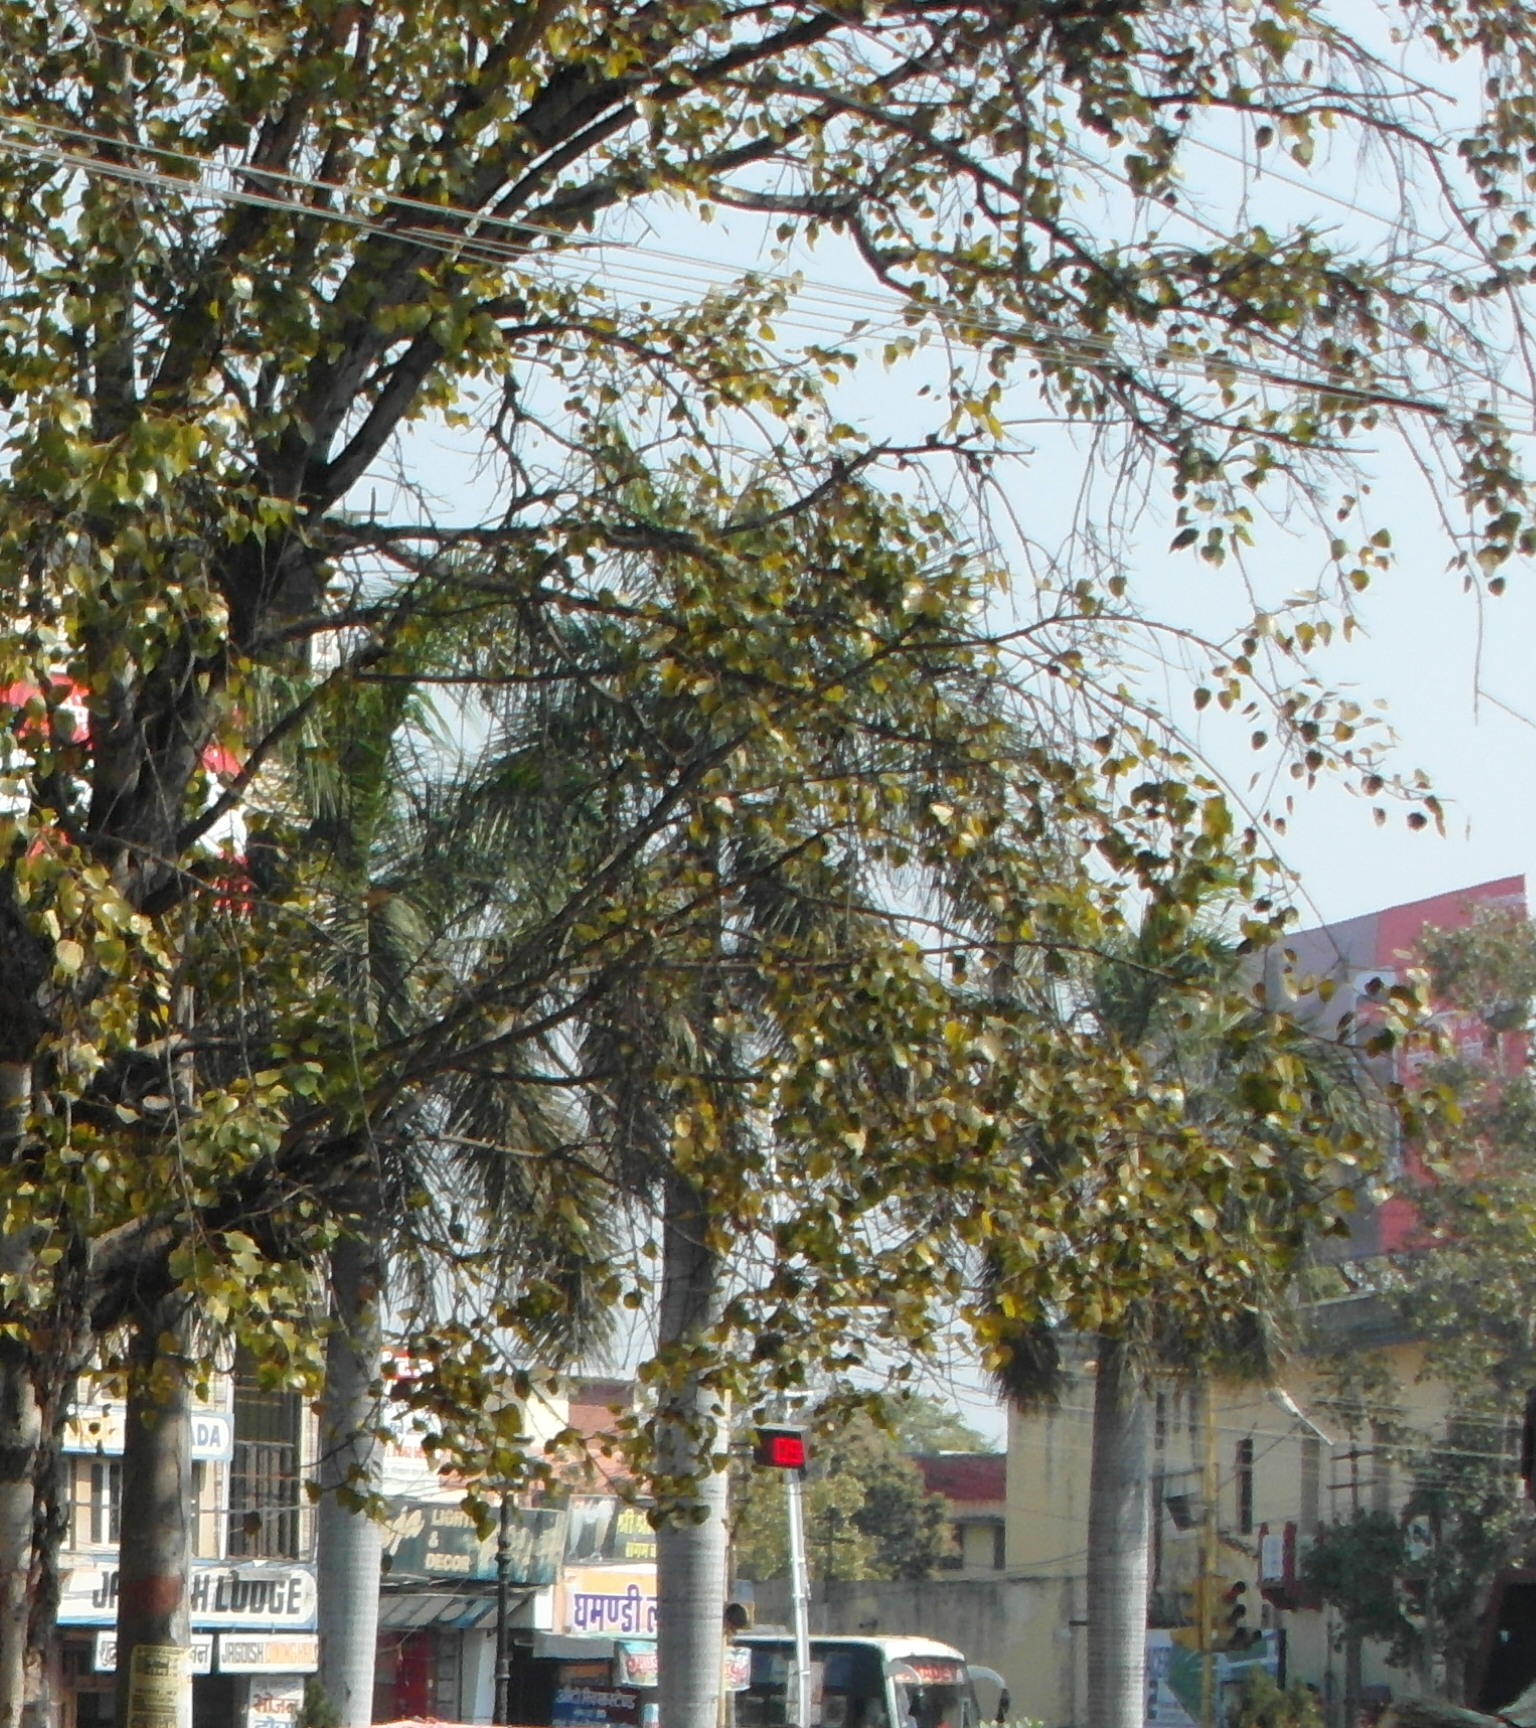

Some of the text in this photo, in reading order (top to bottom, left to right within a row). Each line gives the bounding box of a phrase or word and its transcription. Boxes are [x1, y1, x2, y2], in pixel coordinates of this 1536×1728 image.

[425, 1552, 471, 1573] DECOR
[214, 1570, 302, 1615] LODGE
[574, 1584, 643, 1633] घमण्डी
